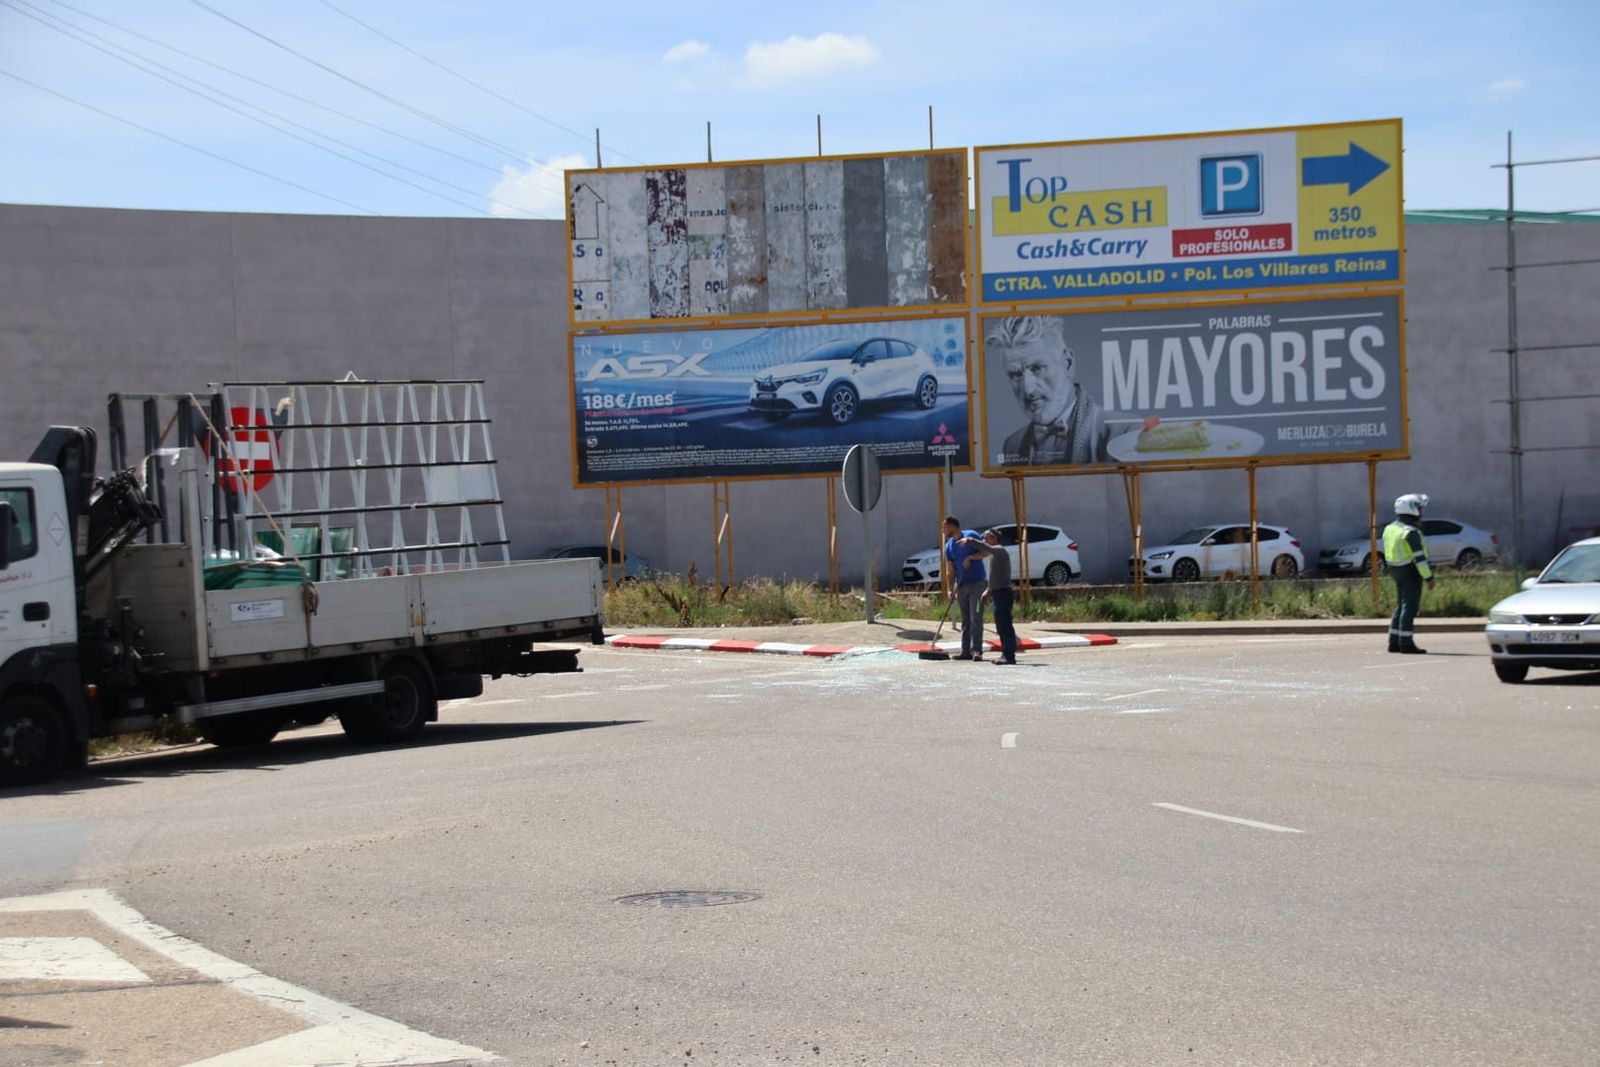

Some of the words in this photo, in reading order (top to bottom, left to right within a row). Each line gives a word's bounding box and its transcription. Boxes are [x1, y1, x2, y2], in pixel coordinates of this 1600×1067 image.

[1215, 159, 1250, 212] P
[1048, 200, 1153, 228] CASH
[1328, 206, 1362, 223] 350
[1214, 228, 1250, 241] SOLO
[1313, 225, 1378, 242] metros
[1016, 237, 1149, 260] Cash&Carry
[1179, 238, 1285, 255] PROFESIONALES
[994, 275, 1048, 293] CTRA.
[1052, 268, 1166, 290] VALLADOLID
[1183, 266, 1217, 282] Pol.
[1222, 264, 1254, 280] Los
[1259, 260, 1330, 278] Villares
[1335, 257, 1388, 274] Reina
[1208, 314, 1272, 330] PALABRAS
[580, 337, 714, 356] NUEVO
[584, 351, 713, 382] ASX
[1101, 324, 1387, 412] MAYORES
[1277, 425, 1327, 441] MERLUZA
[1346, 422, 1388, 438] BURELA
